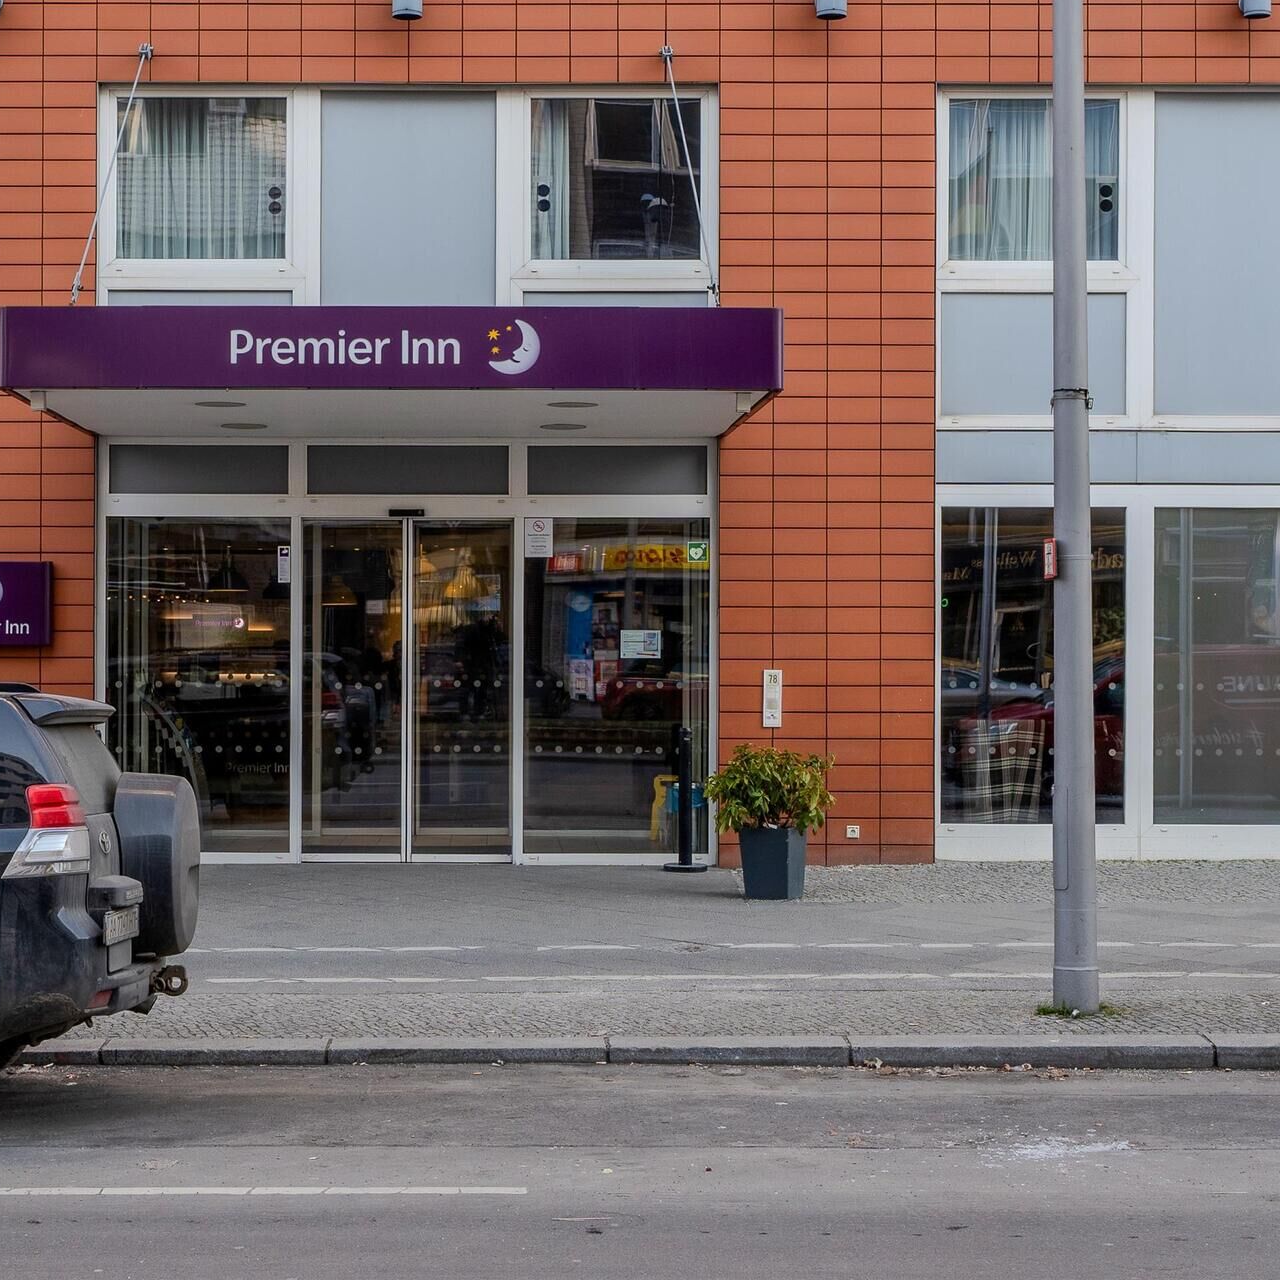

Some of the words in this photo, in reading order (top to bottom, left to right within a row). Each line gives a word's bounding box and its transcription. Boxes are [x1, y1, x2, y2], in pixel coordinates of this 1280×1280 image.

[230, 329, 391, 365] Premier
[401, 329, 461, 365] Inn
[5, 619, 30, 635] Inn
[768, 674, 778, 684] 78
[225, 761, 273, 774] Premier
